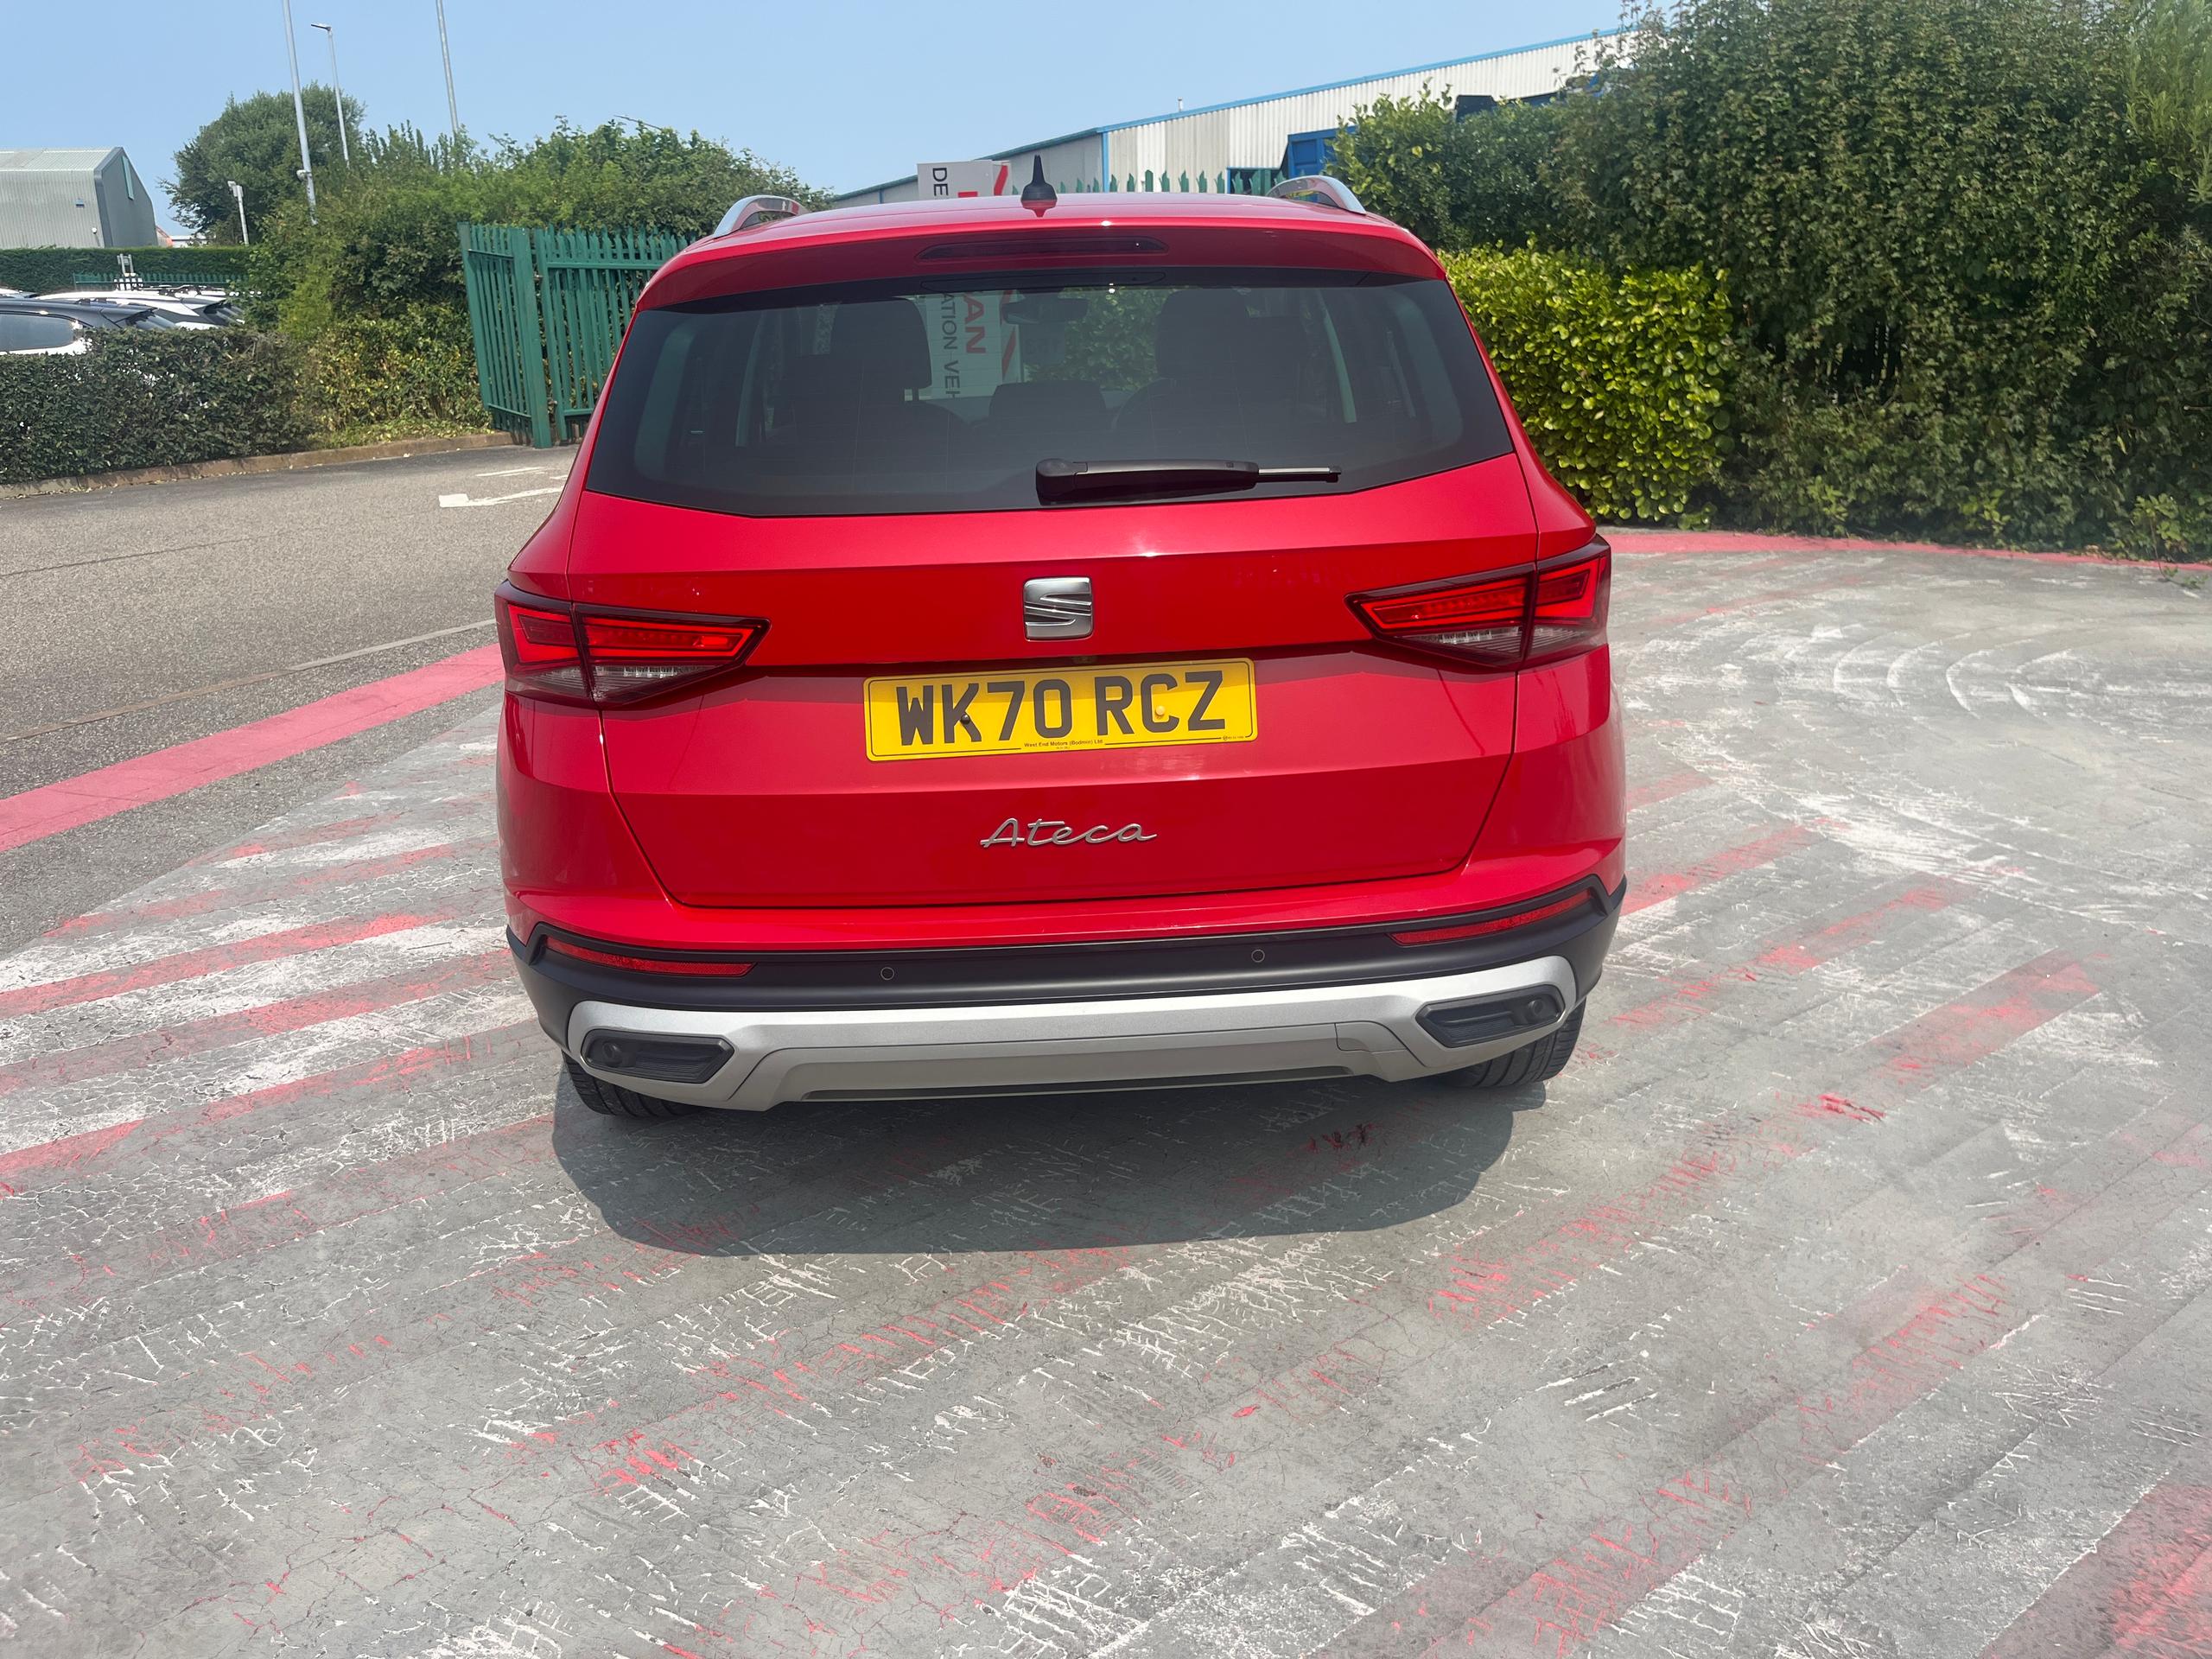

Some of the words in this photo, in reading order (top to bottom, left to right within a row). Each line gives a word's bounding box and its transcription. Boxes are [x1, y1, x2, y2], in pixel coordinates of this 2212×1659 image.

[896, 679, 1072, 746] WK70
[1094, 671, 1225, 737] RCZ
[980, 817, 1157, 849] Ateca
